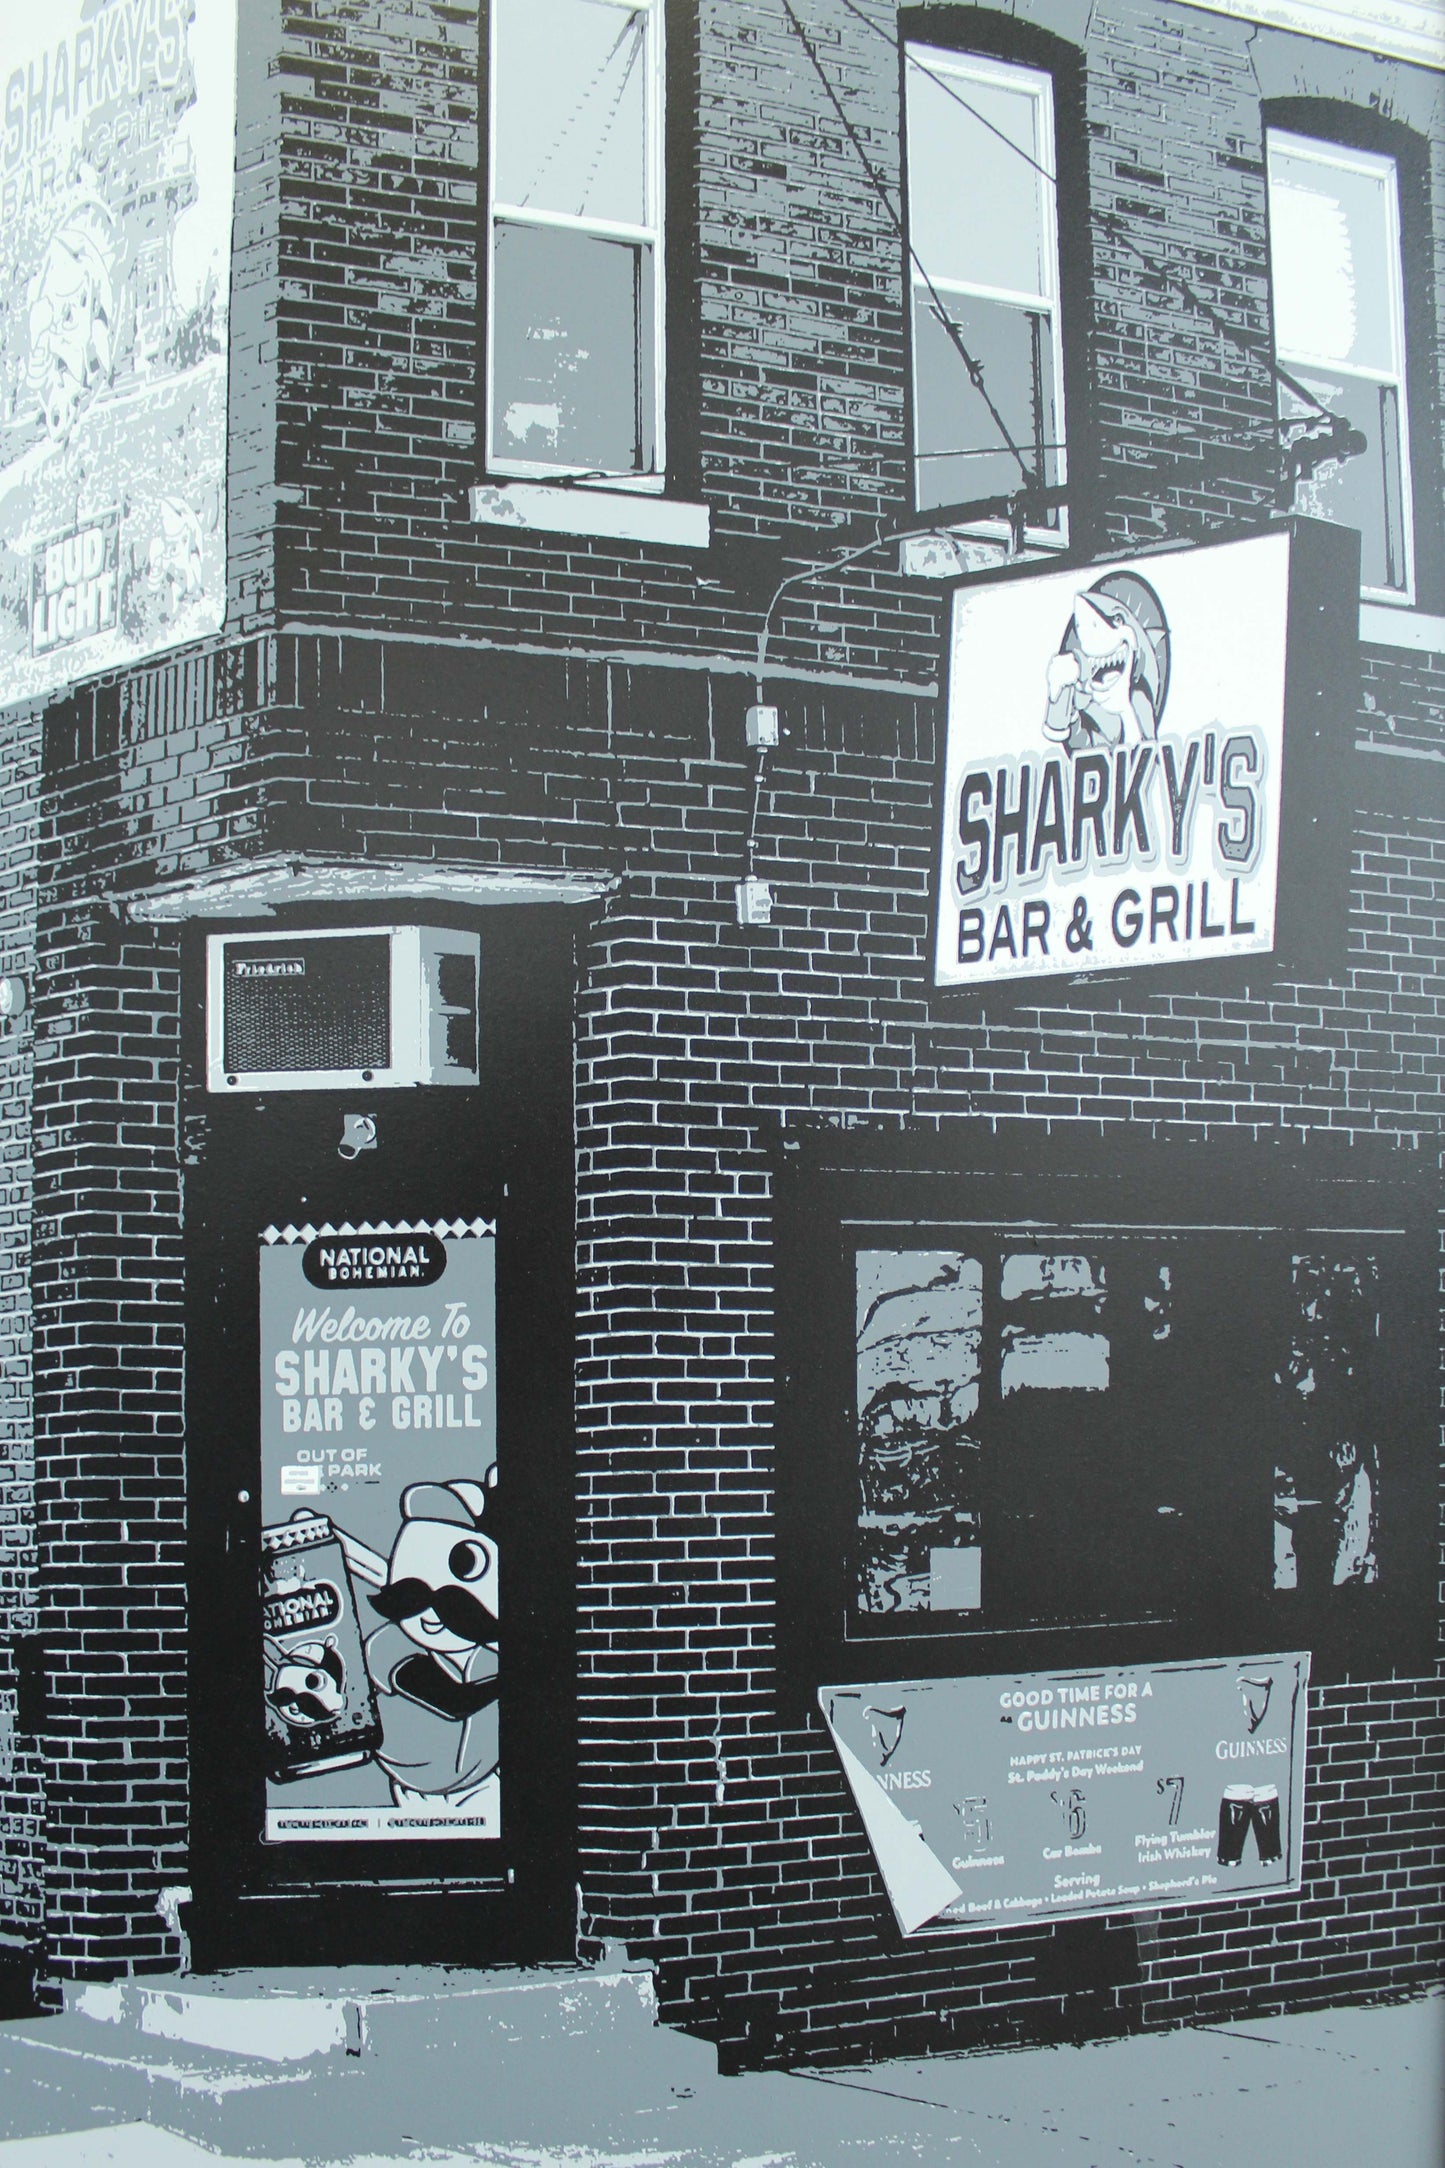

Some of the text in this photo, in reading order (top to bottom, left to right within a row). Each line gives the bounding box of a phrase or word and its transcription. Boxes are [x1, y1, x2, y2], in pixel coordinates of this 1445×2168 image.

[46, 527, 103, 595] BUD
[33, 571, 115, 648] LIGHT
[956, 732, 1259, 897] SHARKY'S
[957, 877, 1256, 964] BAR & GRILL
[319, 1245, 430, 1267] NATIONAL
[291, 1301, 471, 1344] Welcome To
[274, 1344, 488, 1396] SHARKY'S
[282, 1393, 482, 1432] BAR & GRILL
[296, 1448, 368, 1462] OUT OF
[328, 1463, 382, 1477] PARK
[263, 1590, 334, 1618] ATIONAL
[999, 1681, 1153, 1709] GOOD TIME FOR A
[1017, 1702, 1138, 1732] GUINNESS
[1009, 1744, 1142, 1767] HAPPY ST. PATRICK'S DAY
[1215, 1737, 1288, 1760] GUINNESS
[876, 1770, 932, 1791] NNESS
[1026, 1765, 1070, 1782] Paddy's
[1071, 1765, 1094, 1779] Day
[1094, 1759, 1144, 1775] Weekend
[1156, 1776, 1185, 1826] $7
[1135, 1828, 1217, 1848] Flying Tumbler
[952, 1855, 1005, 1870] Guinness
[1043, 1843, 1102, 1860] Car Bombs
[1138, 1846, 1212, 1863] Irish Whiskey
[968, 1899, 993, 1912] Beef
[1003, 1896, 1043, 1908] Cabbage
[1051, 1889, 1084, 1903] Loaded
[1085, 1887, 1116, 1899] Potato
[1118, 1884, 1140, 1897] Soup
[1149, 1876, 1200, 1892] Shepherd's
[1202, 1874, 1218, 1885] Pie
[1054, 1872, 1101, 1889] Serving
